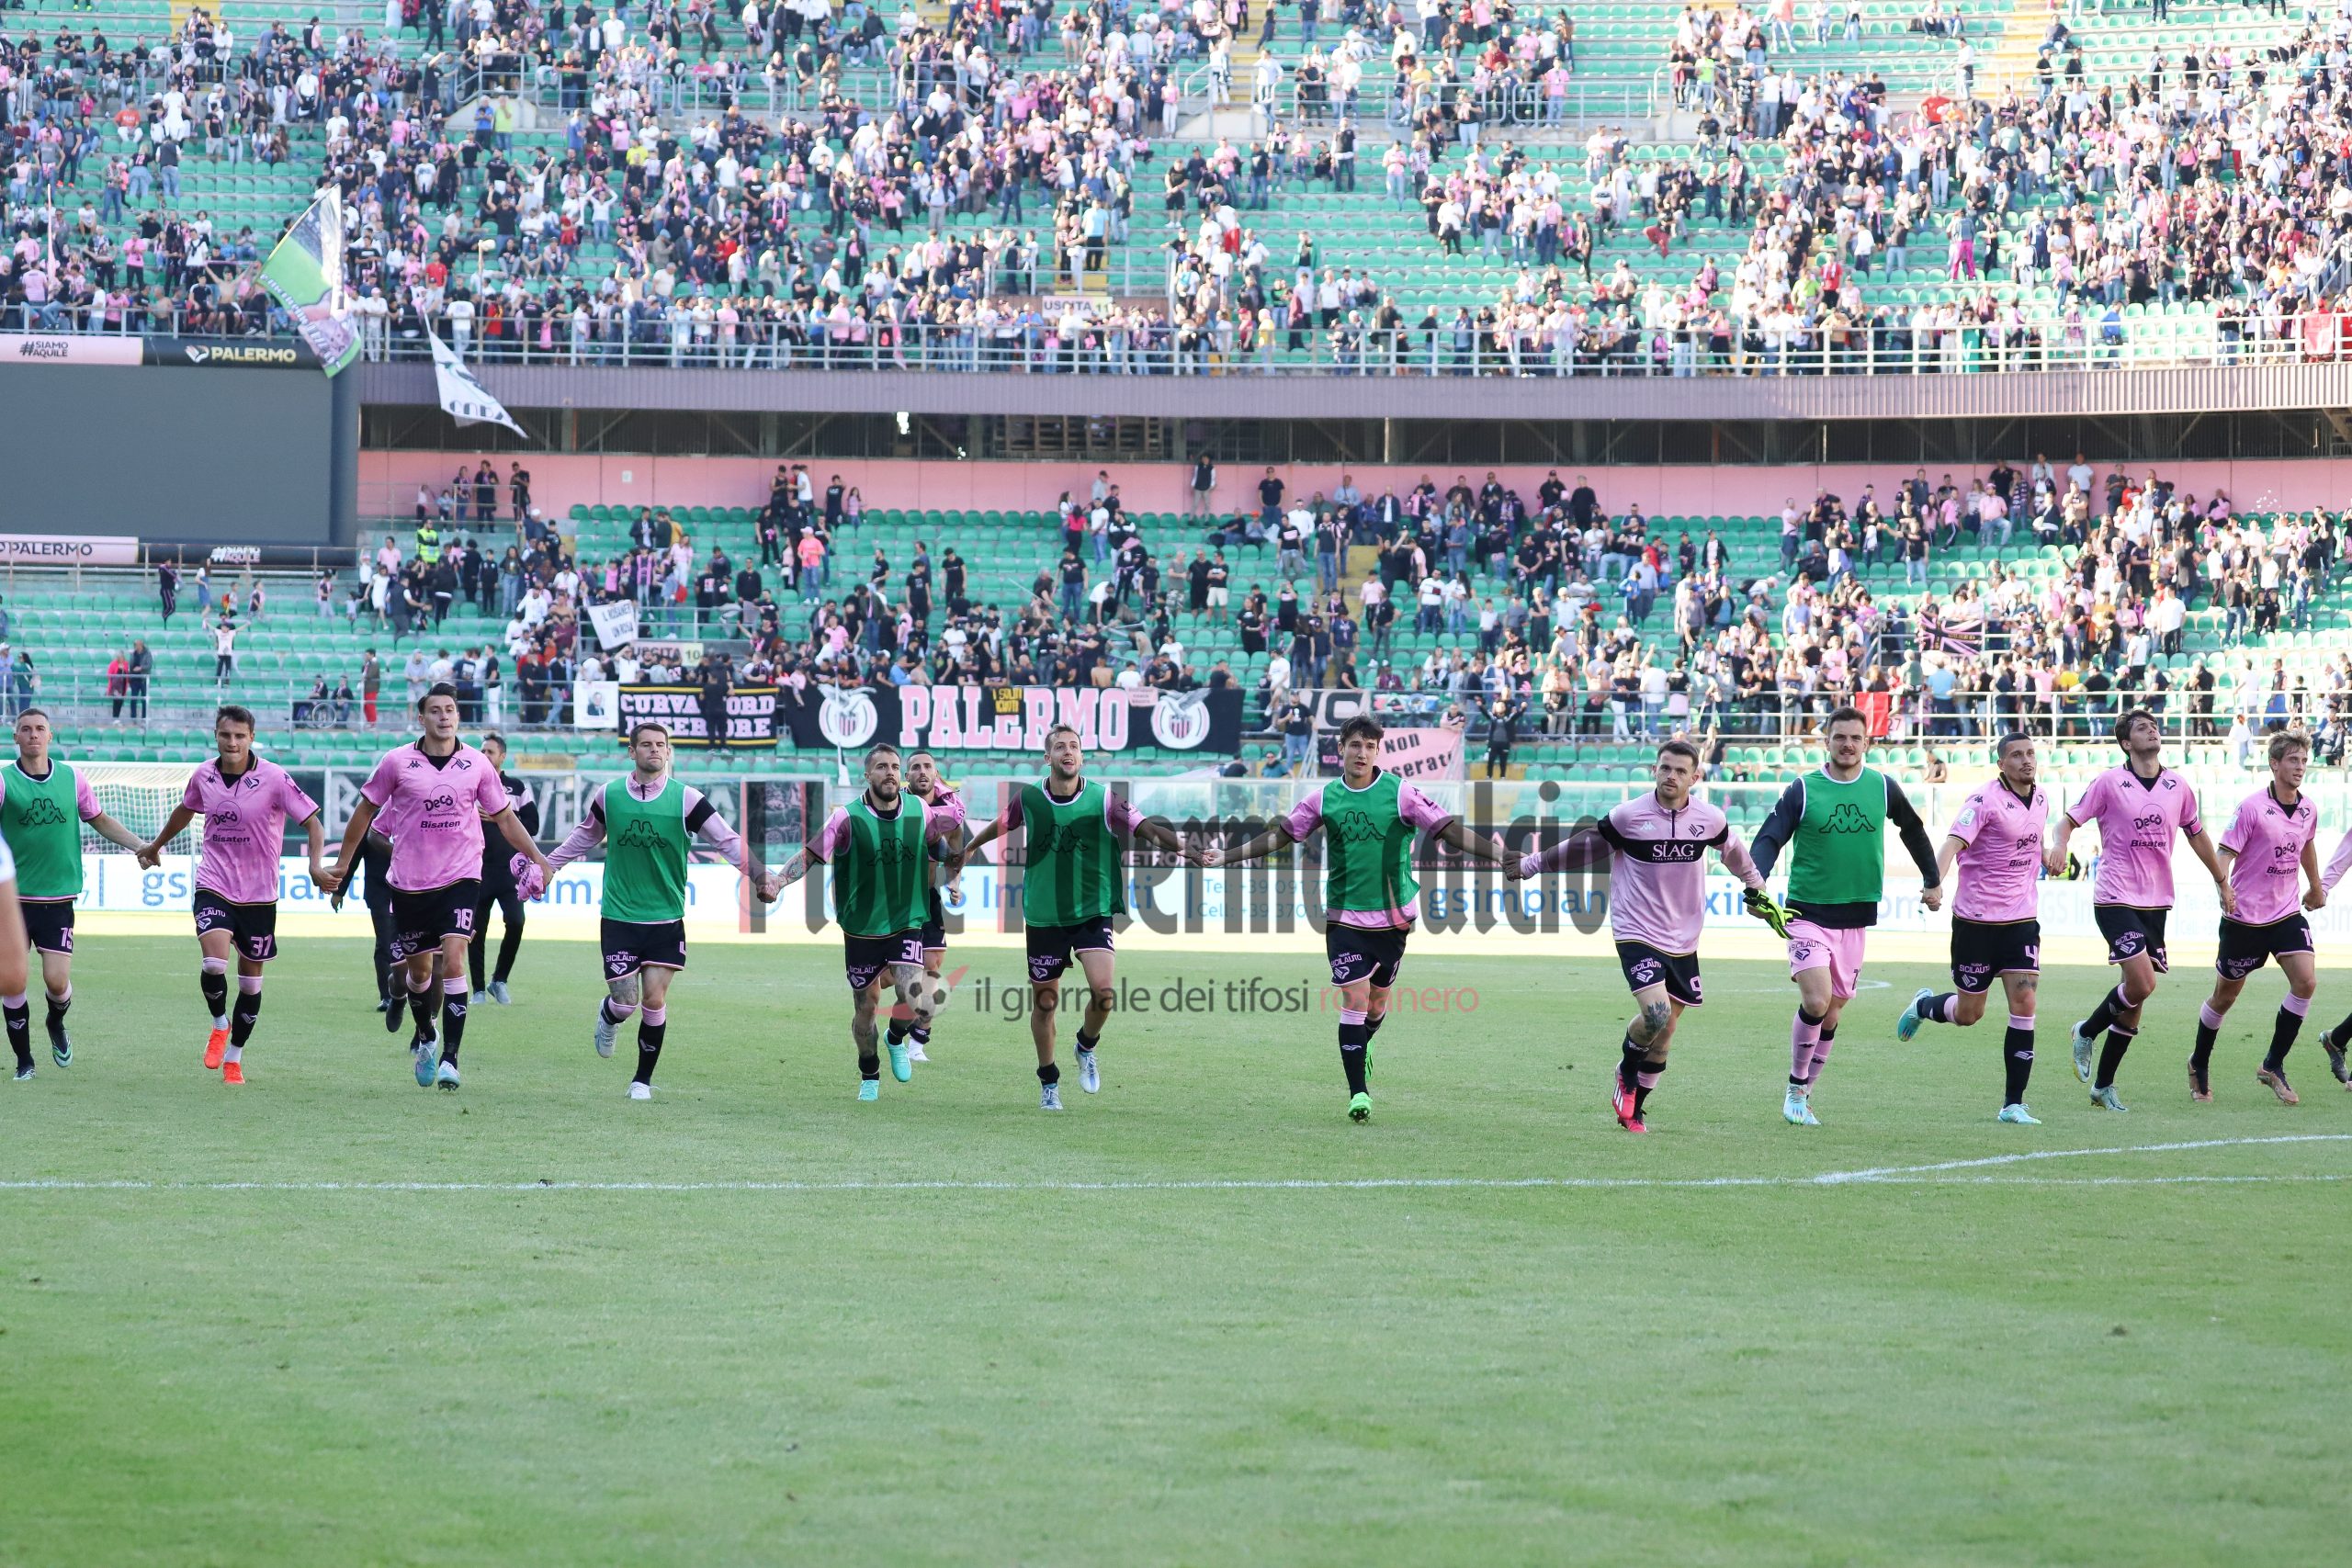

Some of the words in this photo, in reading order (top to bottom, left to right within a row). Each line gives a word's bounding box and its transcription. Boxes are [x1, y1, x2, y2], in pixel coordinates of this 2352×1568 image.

[210, 346, 297, 362] PALERMO
[685, 649, 701, 660] 10
[620, 694, 701, 714] CURVA
[723, 694, 775, 716] ORD
[625, 716, 771, 738] IFERORE
[899, 684, 1129, 751] PALERMO
[420, 820, 461, 829] Bisaten
[212, 834, 251, 843] Bisaten
[2009, 859, 2032, 867] Bisat
[454, 908, 473, 931] 18
[251, 933, 273, 957] 37
[901, 939, 923, 964] 30
